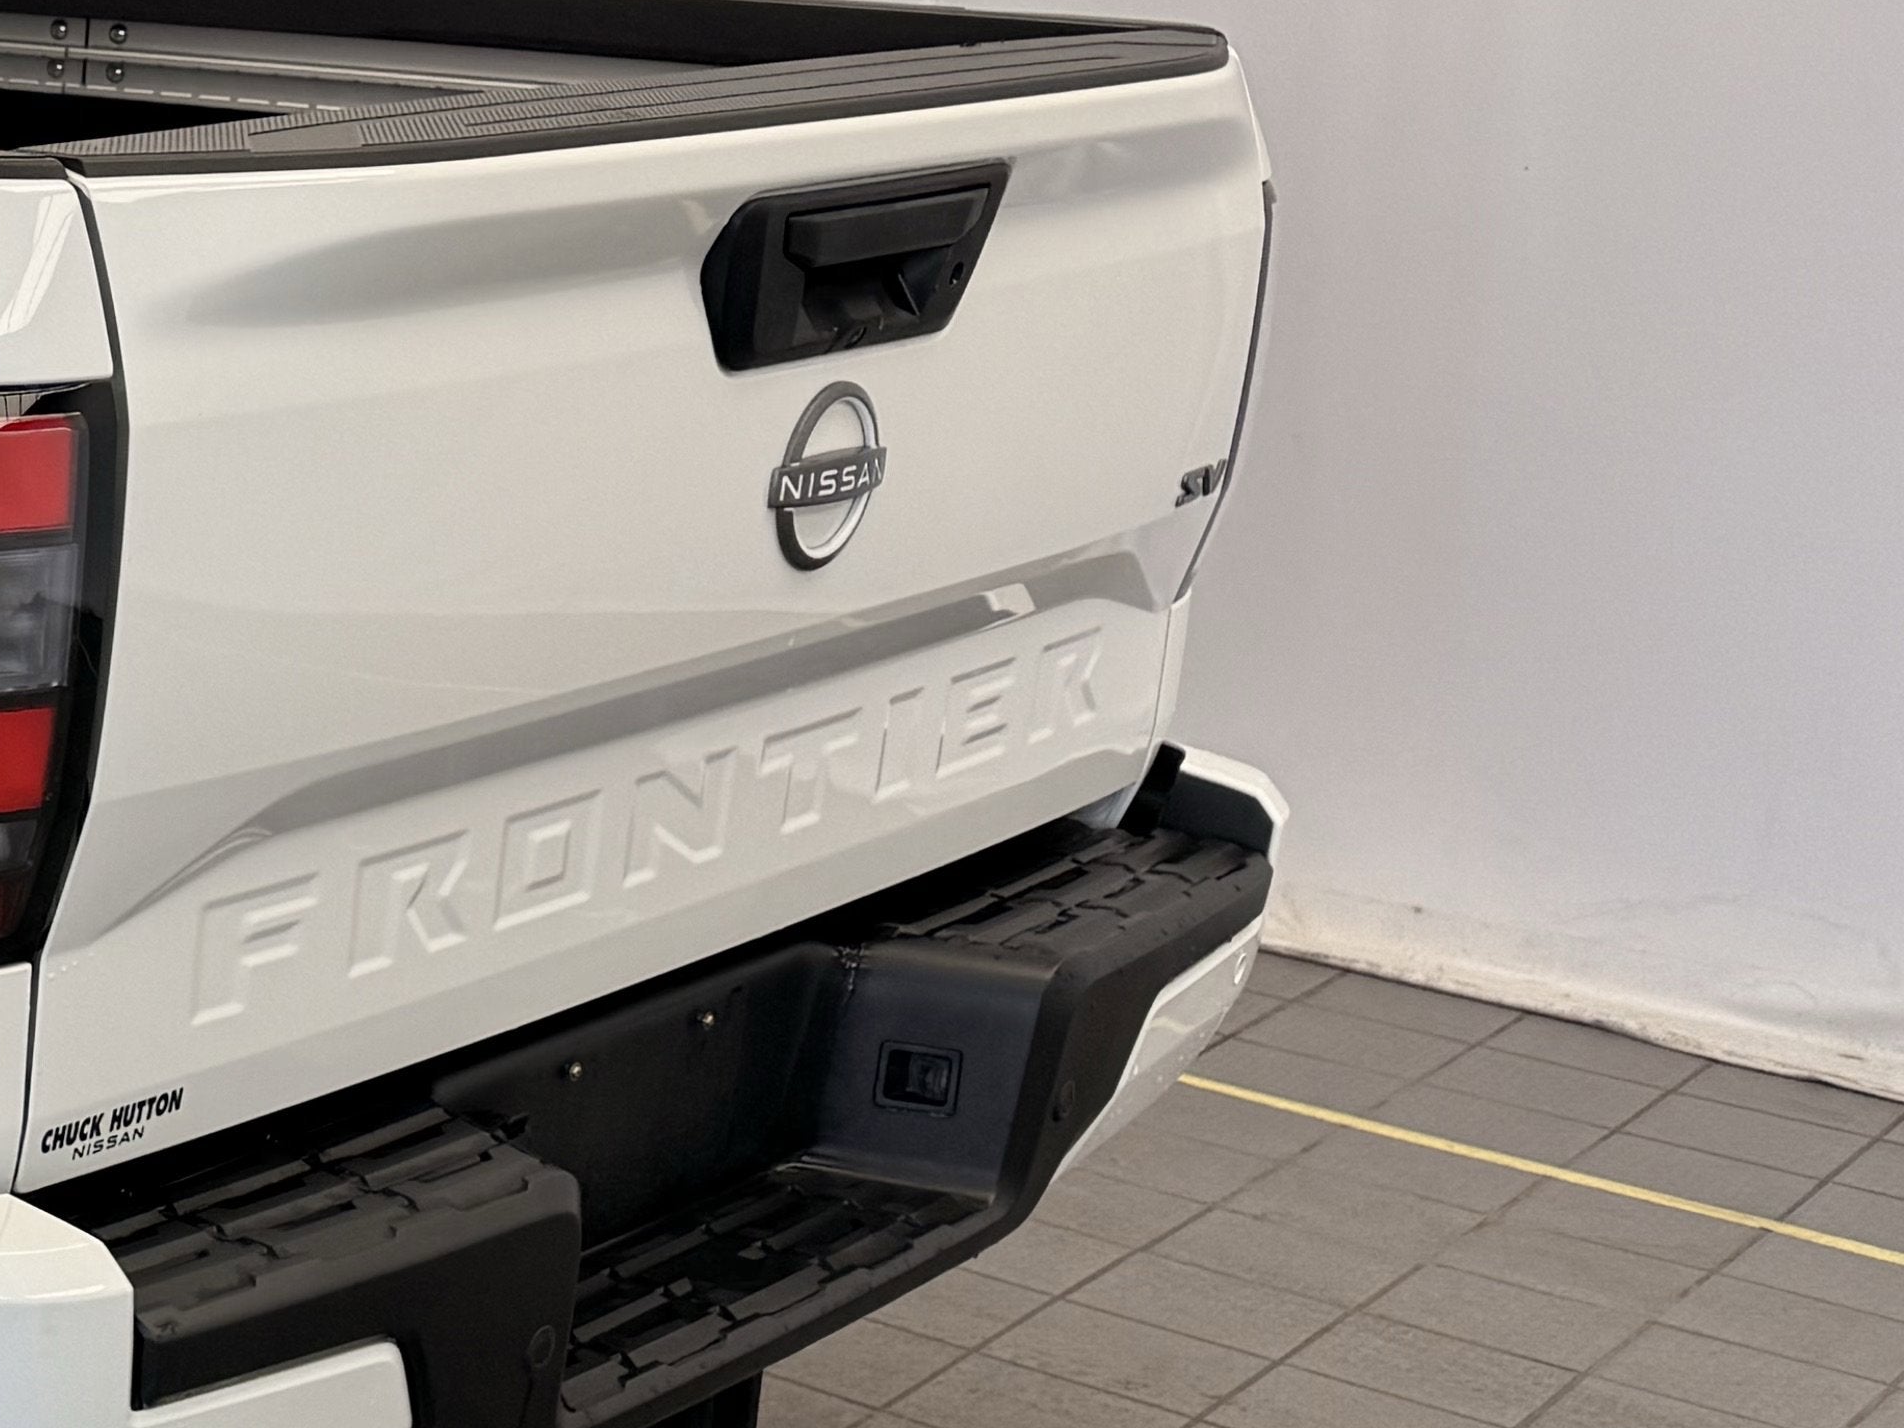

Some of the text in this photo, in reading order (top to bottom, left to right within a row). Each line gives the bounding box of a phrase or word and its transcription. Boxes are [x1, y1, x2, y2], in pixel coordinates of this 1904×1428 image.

[779, 458, 883, 502] NISSAN
[1175, 459, 1226, 507] SV
[191, 626, 1102, 1027] FRONTIER
[41, 1086, 184, 1154] CHUCK HUTTON
[72, 1125, 145, 1161] NISSAN
